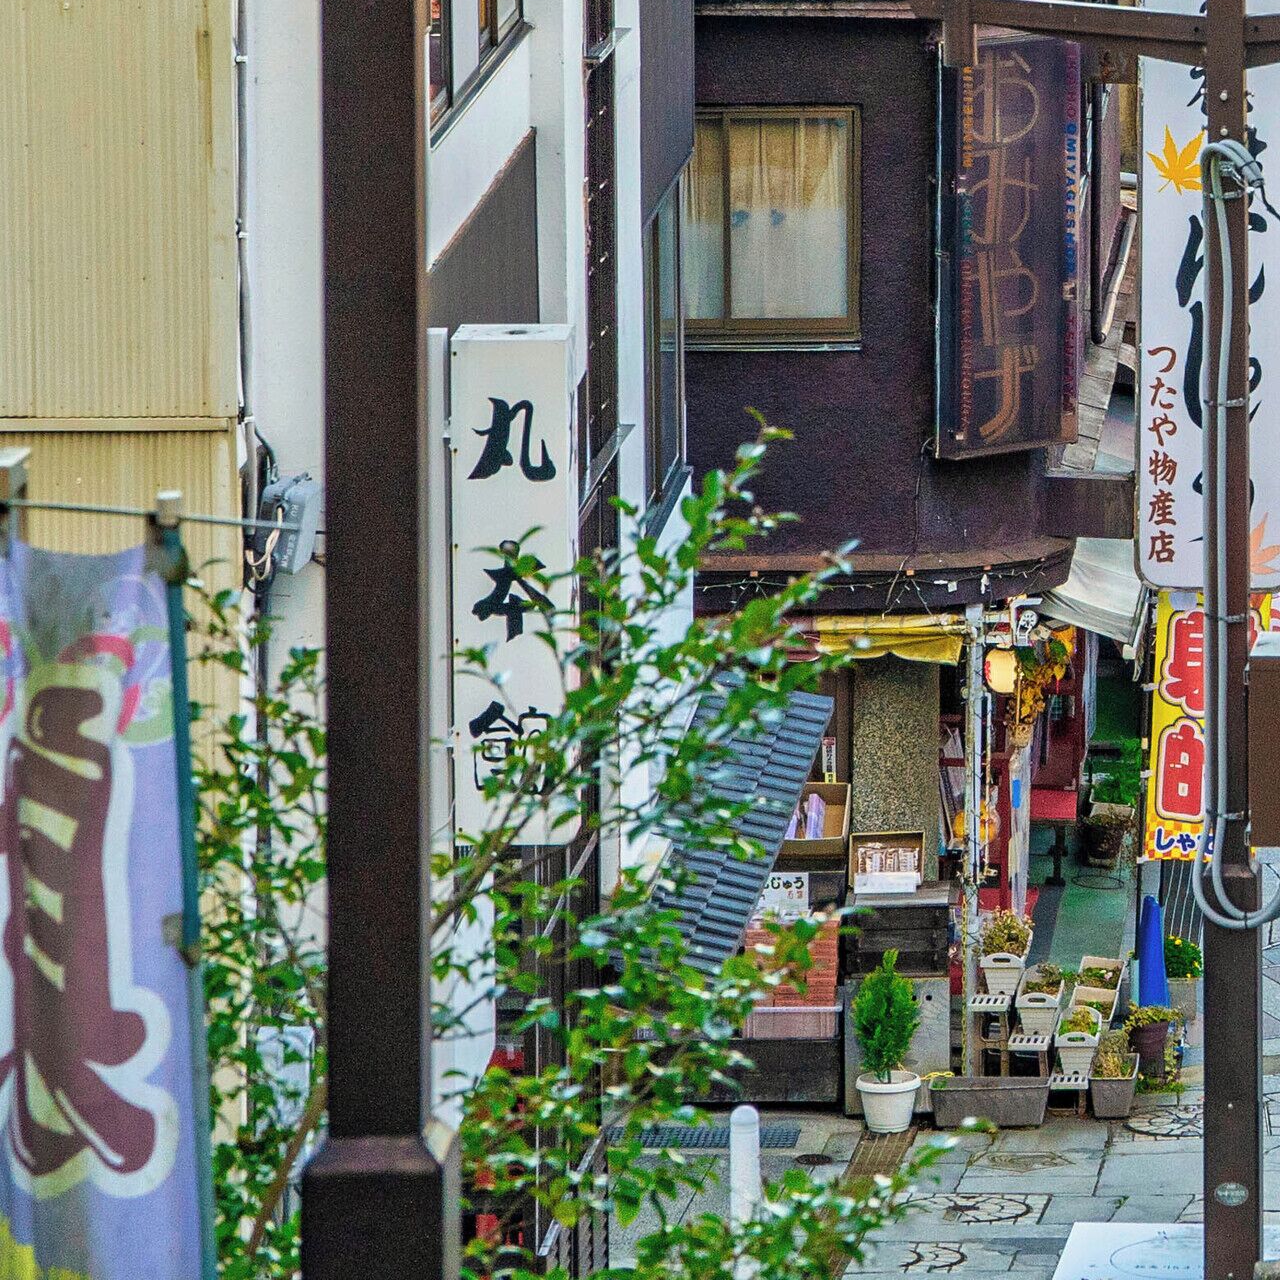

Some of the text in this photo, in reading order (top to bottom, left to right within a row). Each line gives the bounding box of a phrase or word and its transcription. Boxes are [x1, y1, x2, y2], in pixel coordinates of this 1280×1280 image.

[1146, 345, 1179, 565] つたや物産店
[764, 875, 805, 891] じゅう
